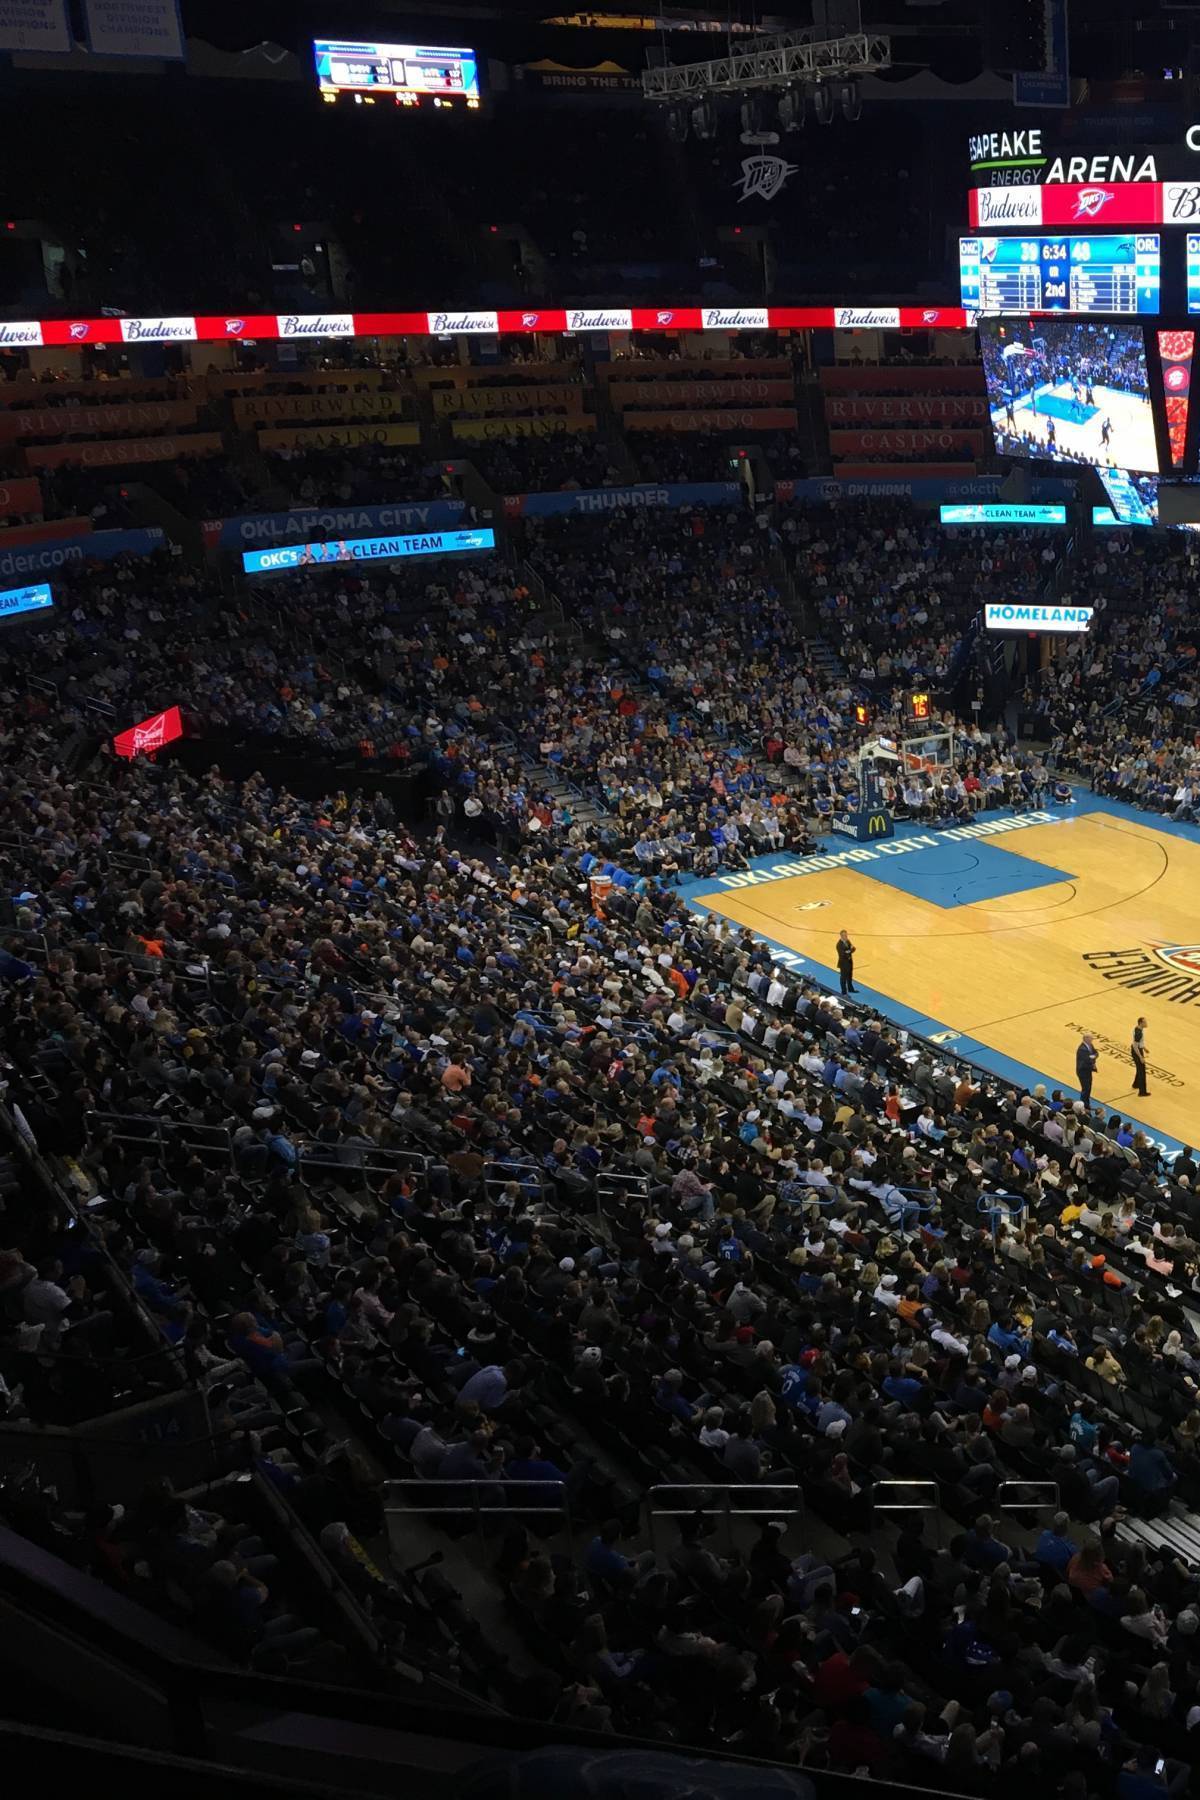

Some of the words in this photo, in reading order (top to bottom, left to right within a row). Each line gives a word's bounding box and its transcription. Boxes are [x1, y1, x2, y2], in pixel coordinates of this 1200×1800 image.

[542, 75, 587, 87] BRING
[592, 77, 624, 88] THE
[990, 168, 1042, 187] ENERGY
[1045, 155, 1158, 184] ARENA
[960, 241, 979, 256] OKC
[1043, 245, 1067, 260] 6:34
[1136, 239, 1159, 253] ORL
[1045, 281, 1066, 297] 2nd
[443, 386, 576, 408] RIVERWIND
[638, 383, 769, 400] RIVERWIND
[245, 396, 393, 417] RIVERWIND
[831, 400, 985, 418] RIVERWIND
[16, 407, 171, 432] RIVERWIND
[483, 419, 568, 437] CASINO
[670, 413, 754, 427] CASINO
[295, 429, 388, 446] CASINO
[861, 434, 953, 449] CASINO
[80, 441, 175, 463] CASINO
[847, 484, 912, 497] OKLAHOMA
[502, 496, 521, 507] 101
[575, 489, 671, 512] THUNDER
[985, 509, 1012, 518] CLEAN
[1014, 510, 1036, 519] TEAM
[239, 510, 373, 540] OKLAHOMA
[378, 507, 430, 528] CITY
[259, 550, 297, 568] OKC's
[352, 540, 401, 558] CLEAN
[404, 536, 443, 552] TEAM
[988, 605, 1090, 623] HOMELAND
[832, 817, 858, 840] SPALDING
[719, 848, 882, 889] OKLAHOMA
[875, 835, 940, 857] CITY
[933, 811, 1062, 842] THUNDER
